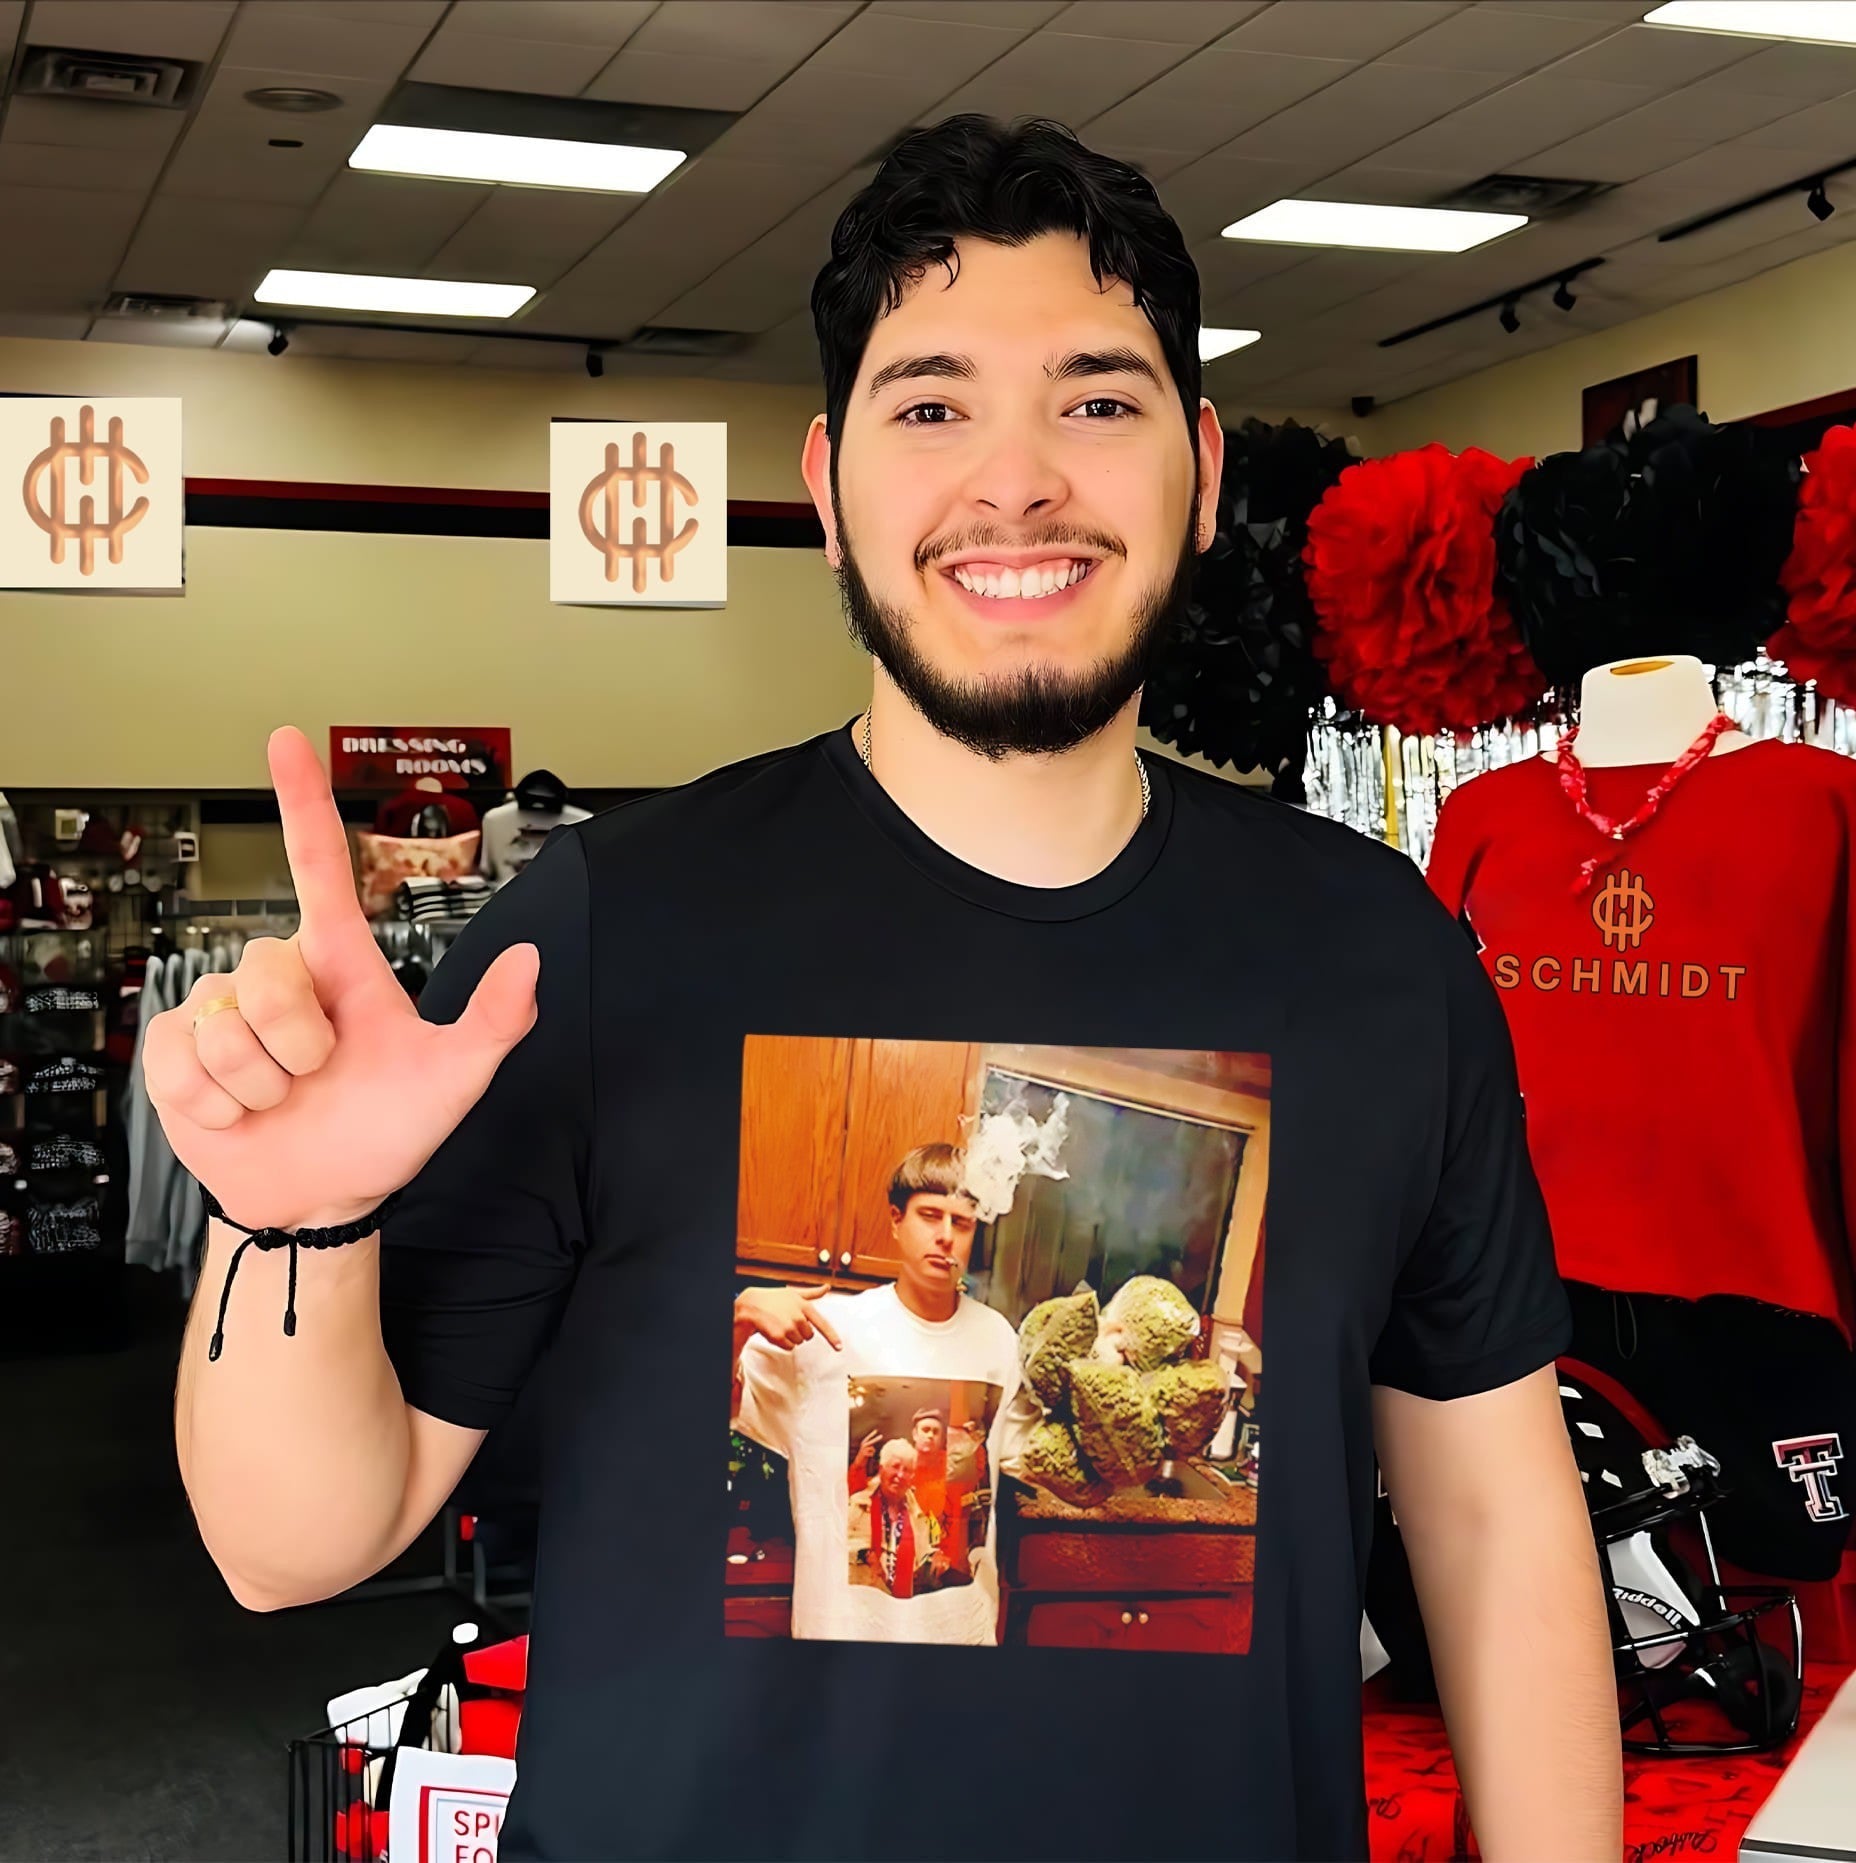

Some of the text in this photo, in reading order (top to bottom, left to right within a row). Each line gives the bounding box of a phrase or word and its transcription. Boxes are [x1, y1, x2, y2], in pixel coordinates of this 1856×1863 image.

[342, 737, 467, 754] DRESSING
[396, 758, 488, 775] ROOMS
[1493, 953, 1747, 1000] SCHMIDT
